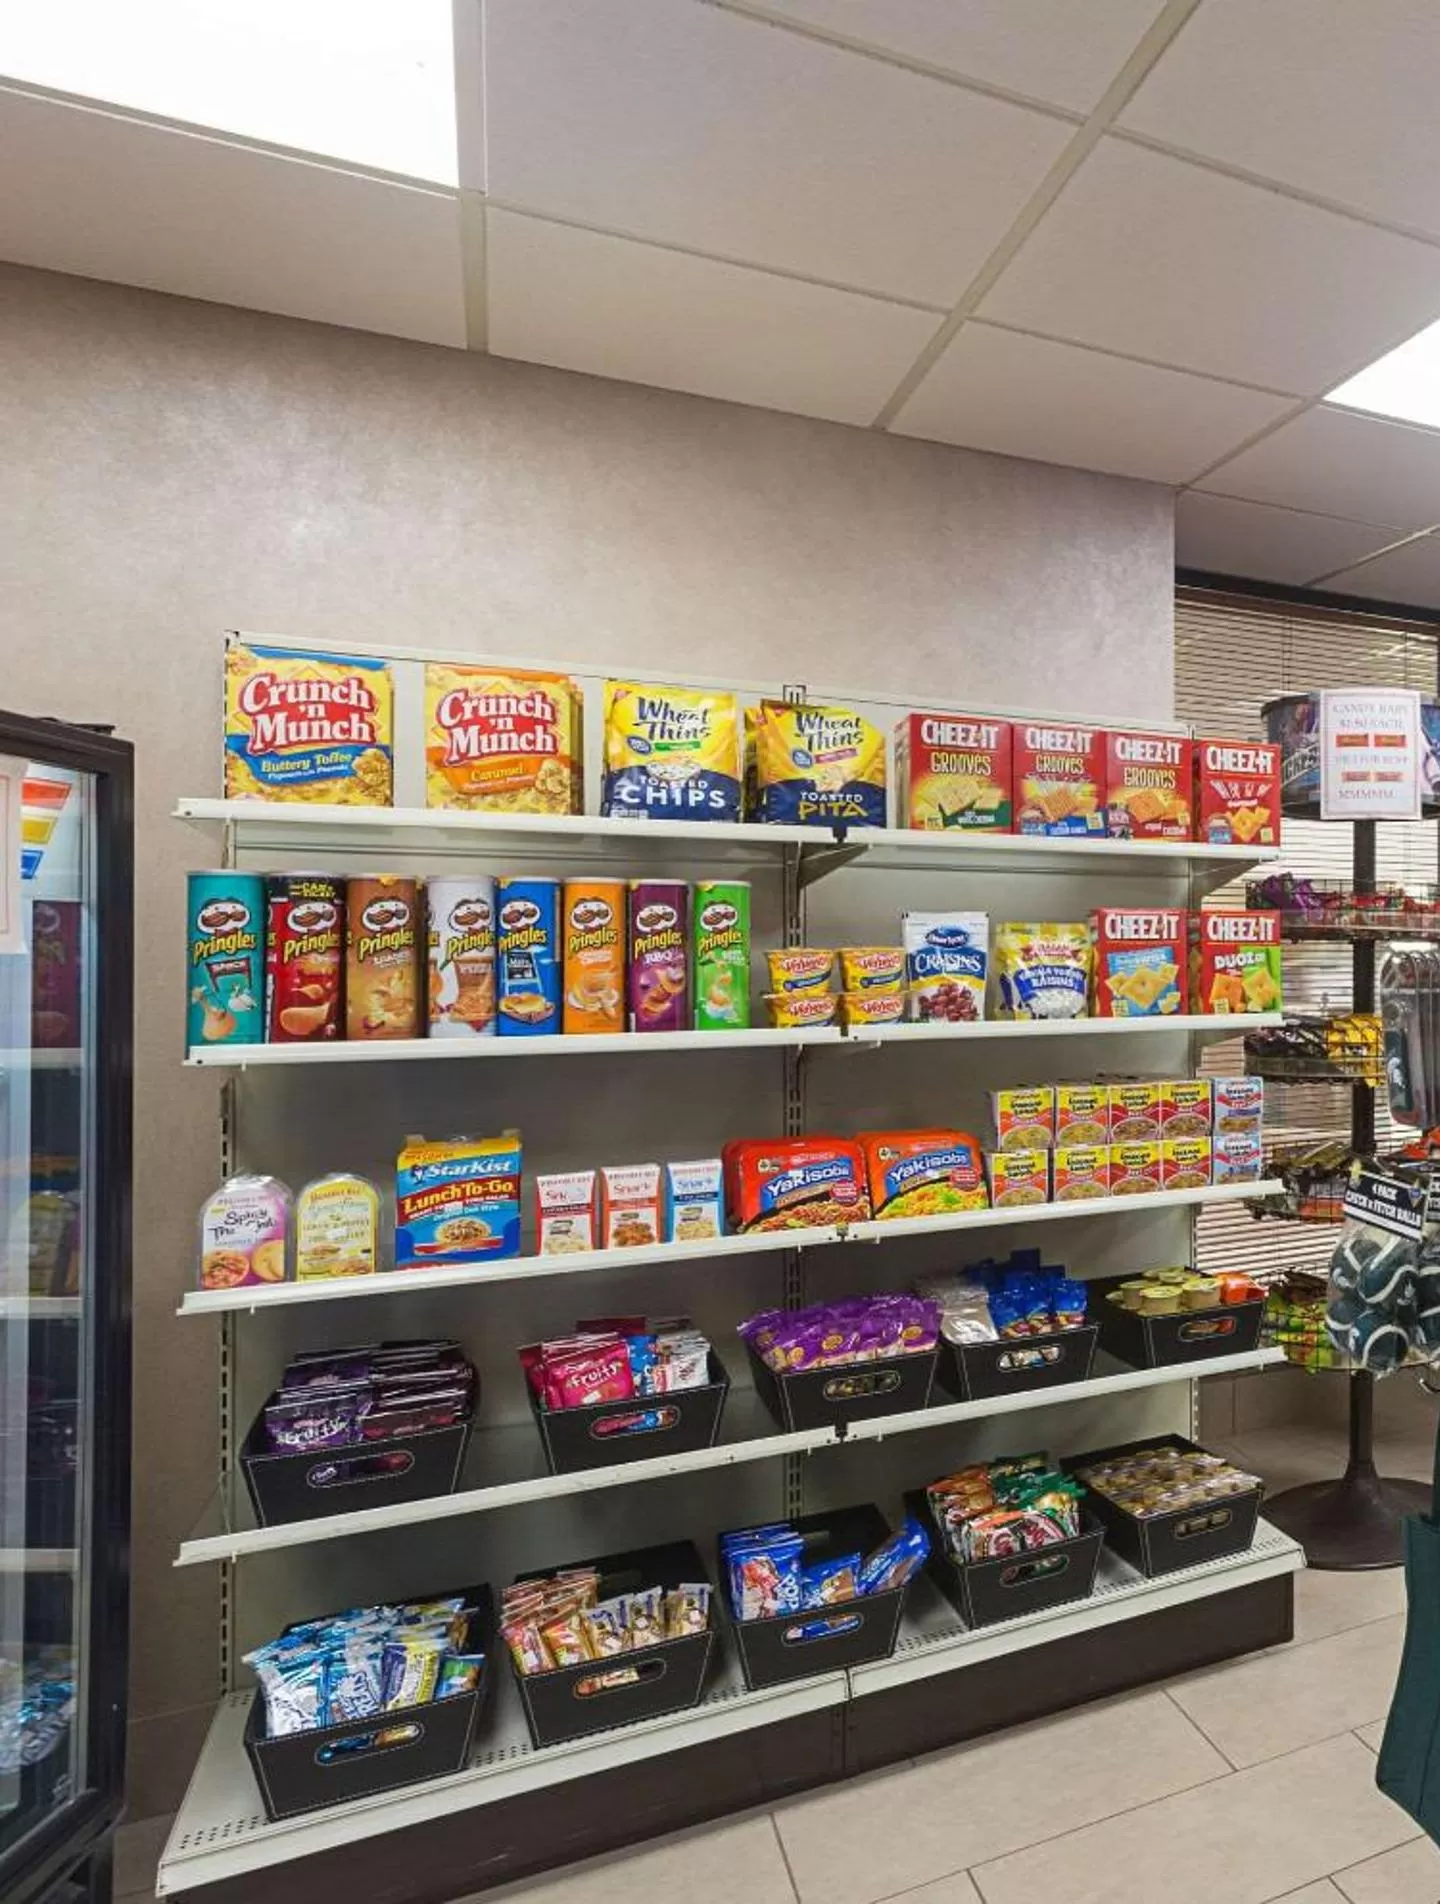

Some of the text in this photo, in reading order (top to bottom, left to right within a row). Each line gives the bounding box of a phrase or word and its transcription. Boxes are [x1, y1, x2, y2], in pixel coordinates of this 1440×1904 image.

[243, 676, 371, 713] Crunch
[299, 704, 325, 718] 'n
[440, 692, 552, 727] Crunch
[637, 697, 710, 723] Wheat
[253, 712, 372, 749] Munch
[490, 718, 513, 730] 'n
[632, 722, 711, 740] Thins
[797, 711, 861, 733] Wheat
[449, 725, 554, 762] Munch
[794, 731, 863, 751] Thins
[262, 753, 351, 772] Buttery Toffee
[471, 763, 524, 782] Caramel
[620, 785, 725, 808] CHIPS
[800, 791, 863, 803] TOASTED
[799, 801, 868, 820] PITA
[284, 930, 340, 963] Pringle
[500, 929, 547, 952] ringles
[569, 928, 617, 952] Pringles
[634, 930, 682, 960] Pringles
[914, 952, 981, 973] CRAISINS
[427, 1159, 512, 1177] StarKist
[892, 1152, 967, 1183] Yakisoba
[404, 1184, 461, 1214] Lunch
[462, 1180, 514, 1196] To-Go
[1396, 1208, 1421, 1226] BALLS
